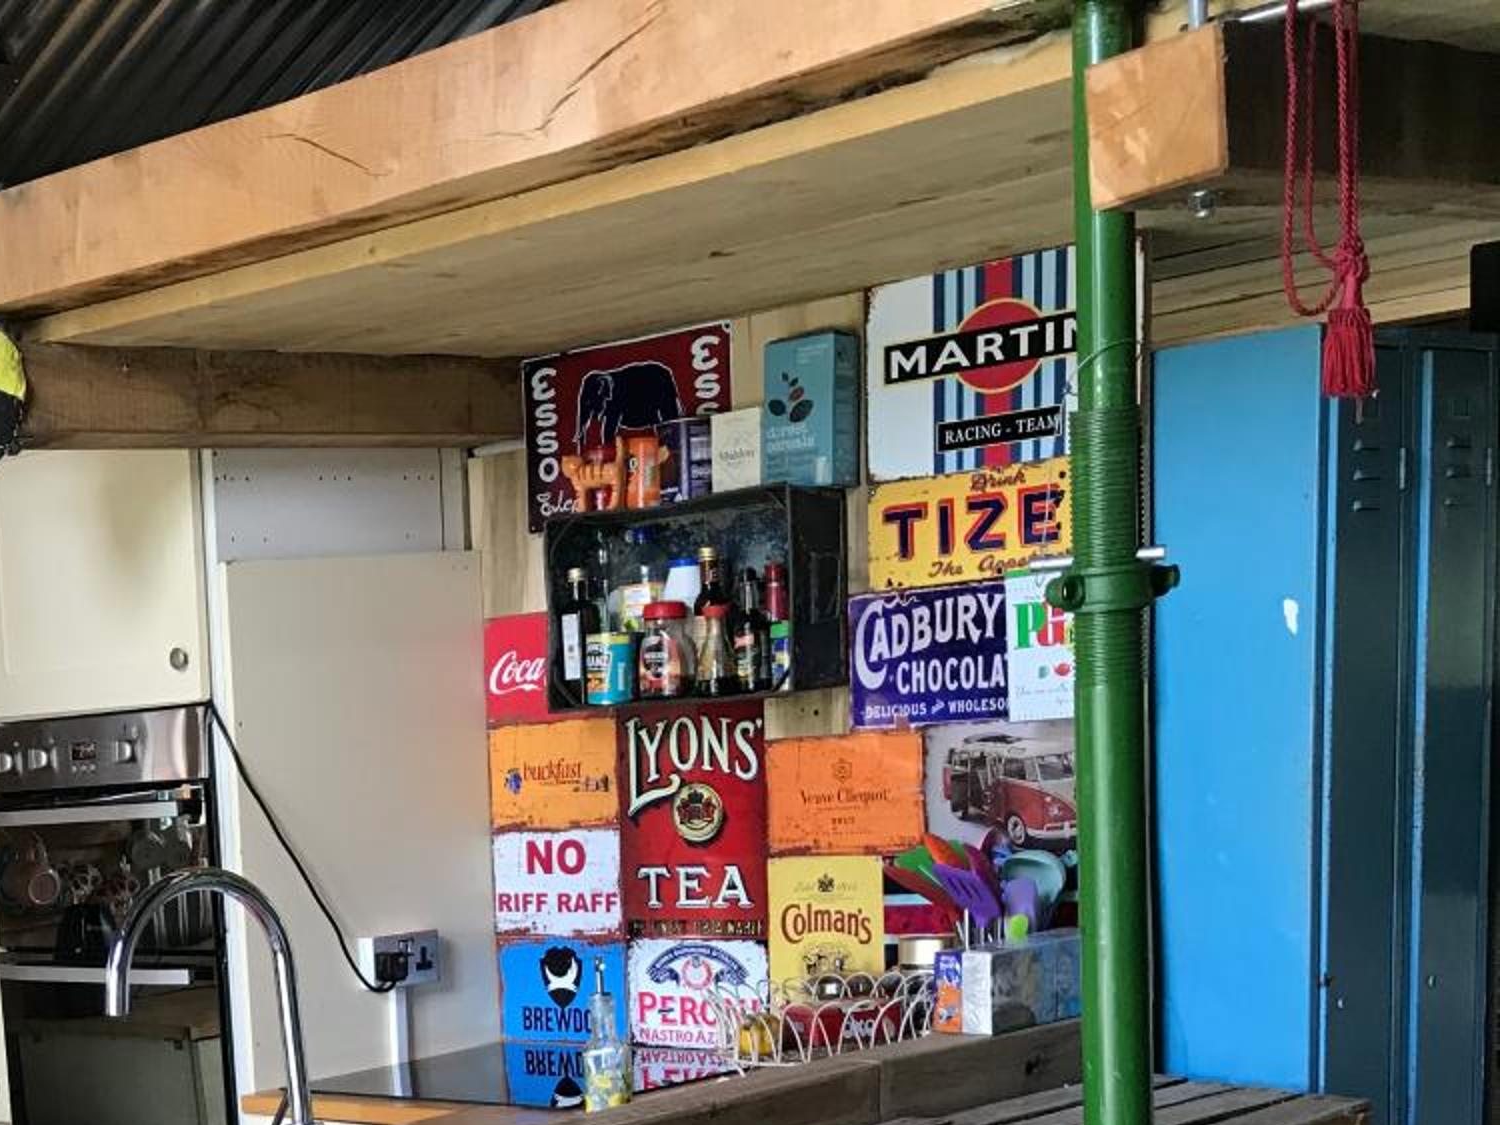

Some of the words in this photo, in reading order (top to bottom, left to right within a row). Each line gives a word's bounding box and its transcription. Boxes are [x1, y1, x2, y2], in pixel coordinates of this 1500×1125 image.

[890, 320, 1076, 380] MARTIN
[691, 334, 721, 415] ESS
[945, 423, 1001, 444] RACING
[1015, 413, 1062, 434] TEAM
[882, 483, 1065, 561] TIZE
[929, 561, 964, 578] The
[855, 592, 1005, 690] CADBURY
[896, 653, 1008, 695] CHOCOLA
[864, 702, 928, 720] DELICIOUS
[948, 696, 1006, 715] WHOLESO
[526, 839, 587, 875] NO
[498, 893, 549, 913] RIFF
[557, 892, 617, 913] RAFF
[637, 865, 754, 909] TEA
[781, 903, 872, 945] Colman's
[523, 1007, 591, 1033] BREWDO
[640, 1027, 693, 1043] NASTRO
